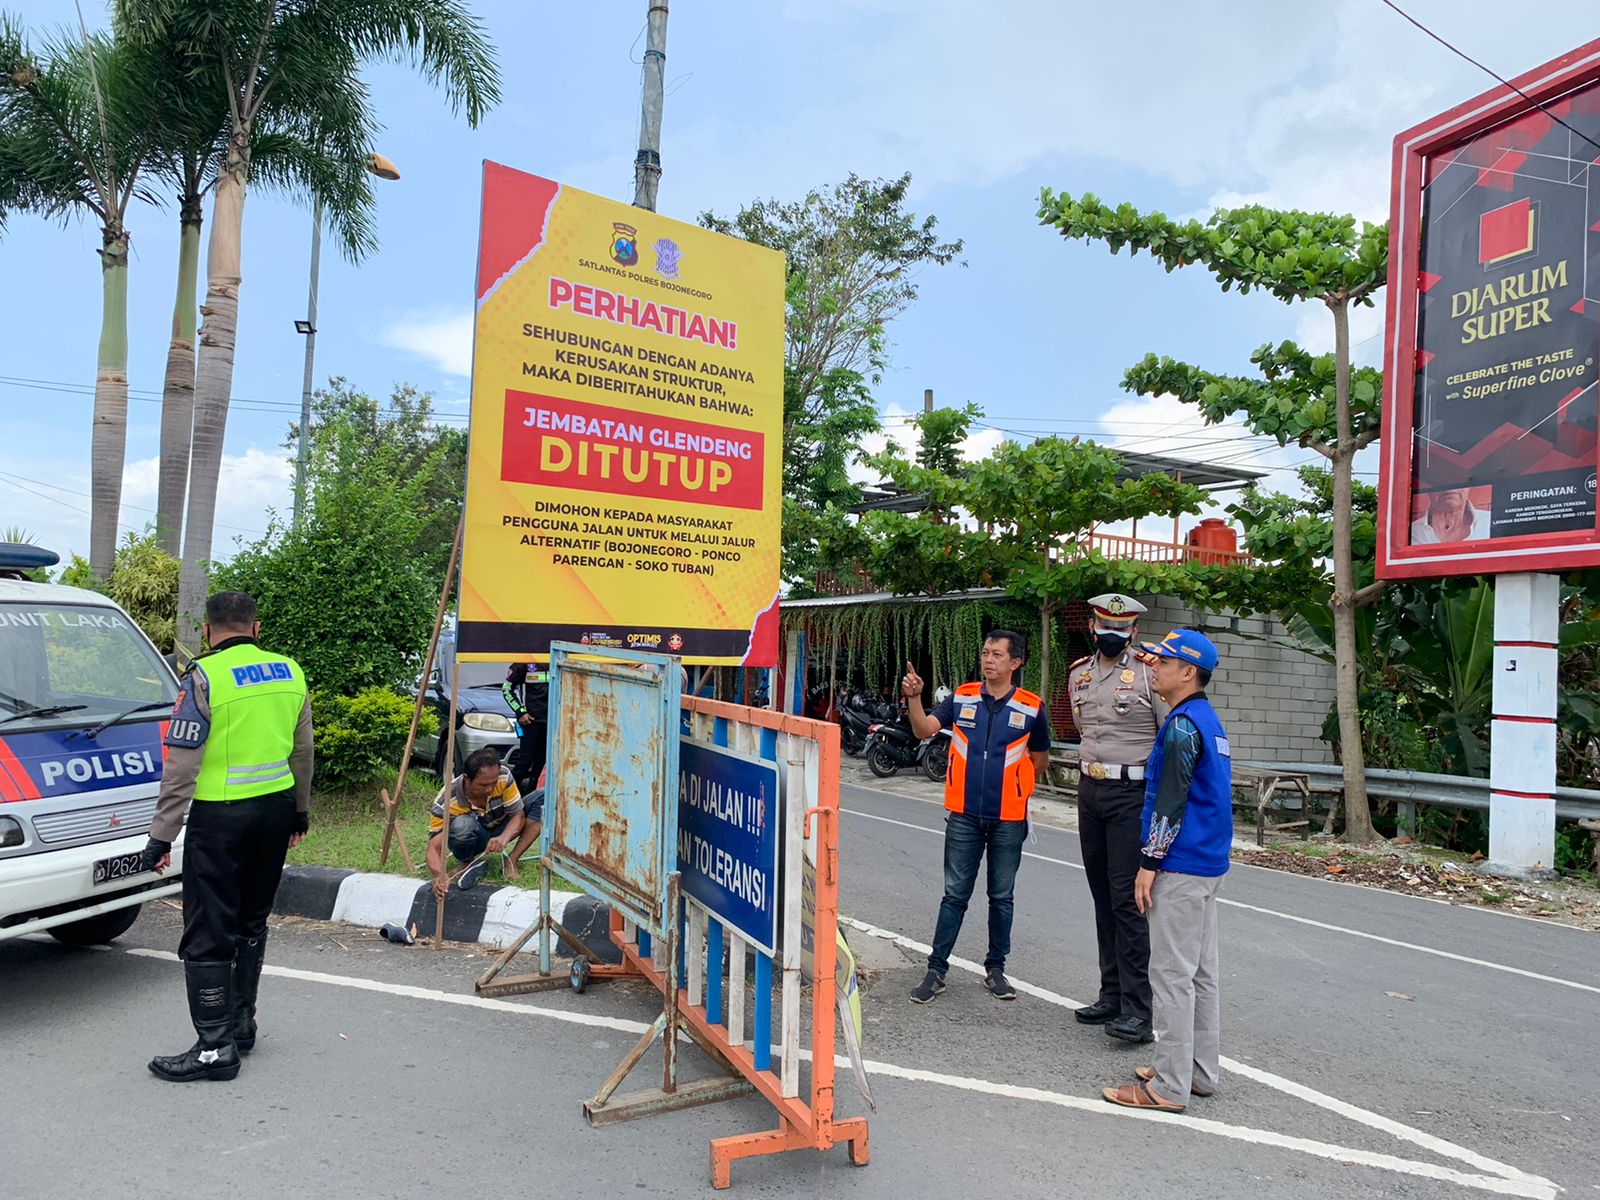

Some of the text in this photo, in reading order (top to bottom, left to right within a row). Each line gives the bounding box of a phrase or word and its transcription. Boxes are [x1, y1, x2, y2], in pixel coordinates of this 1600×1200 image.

[578, 258, 713, 300] SATLANTAS POLRES BOJONEGORO
[1451, 260, 1568, 318] DJARUM
[549, 276, 737, 351] PERHATIAN!
[1461, 297, 1553, 344] SUPER
[522, 323, 754, 384] SEHUBUNGAN DENGAN ADANYA
[555, 349, 726, 396] KERUSAKAN STRUKTUR,
[1446, 348, 1575, 385] CELEBRATE THE TASTE
[522, 362, 754, 417] MAKA DIBERITAHUKAN BAHWA:
[1462, 374, 1536, 400] Superfine
[523, 407, 752, 460] JEMBATAN GLENDENG
[540, 435, 733, 492] DITUTUP
[1510, 485, 1577, 501] PERINGATAN:
[502, 515, 755, 548] PENGGUNA JALAN UNTUK MELALUI JALUR
[534, 501, 733, 531] DIMOHON KEPADA MASYARAKAT
[520, 535, 601, 551] ALTERNATIF
[604, 540, 691, 559] (BOJONEGORO
[701, 549, 741, 562] PONCO
[552, 554, 625, 569] PARENGAN
[635, 559, 669, 572] SOKO
[671, 562, 714, 577] TUBAN)
[58, 613, 128, 629] LAKA
[626, 633, 661, 644] OPTIMIS
[234, 664, 293, 686] POLISI
[40, 750, 155, 786] POLISI
[690, 773, 701, 808] DI
[703, 779, 744, 829] JALAN
[694, 836, 766, 911] TOLERANSI
